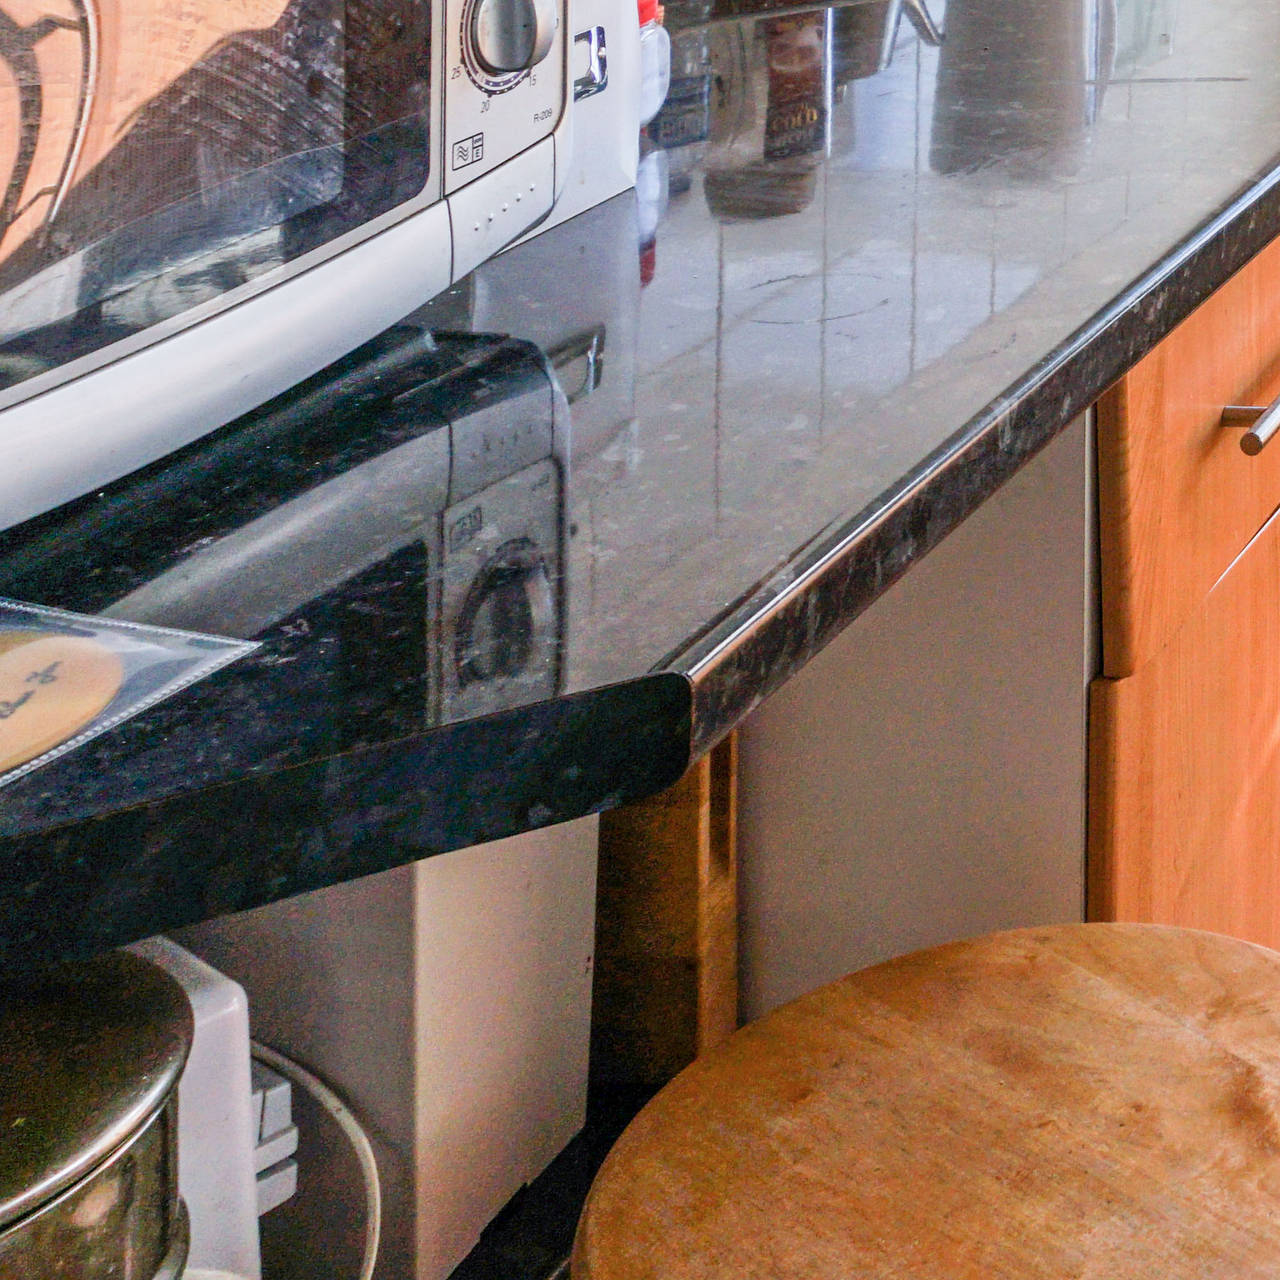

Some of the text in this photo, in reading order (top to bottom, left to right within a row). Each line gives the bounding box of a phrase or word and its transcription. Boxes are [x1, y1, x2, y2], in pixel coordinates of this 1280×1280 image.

[451, 65, 461, 80] 25
[528, 74, 537, 87] 15
[480, 99, 490, 114] 20
